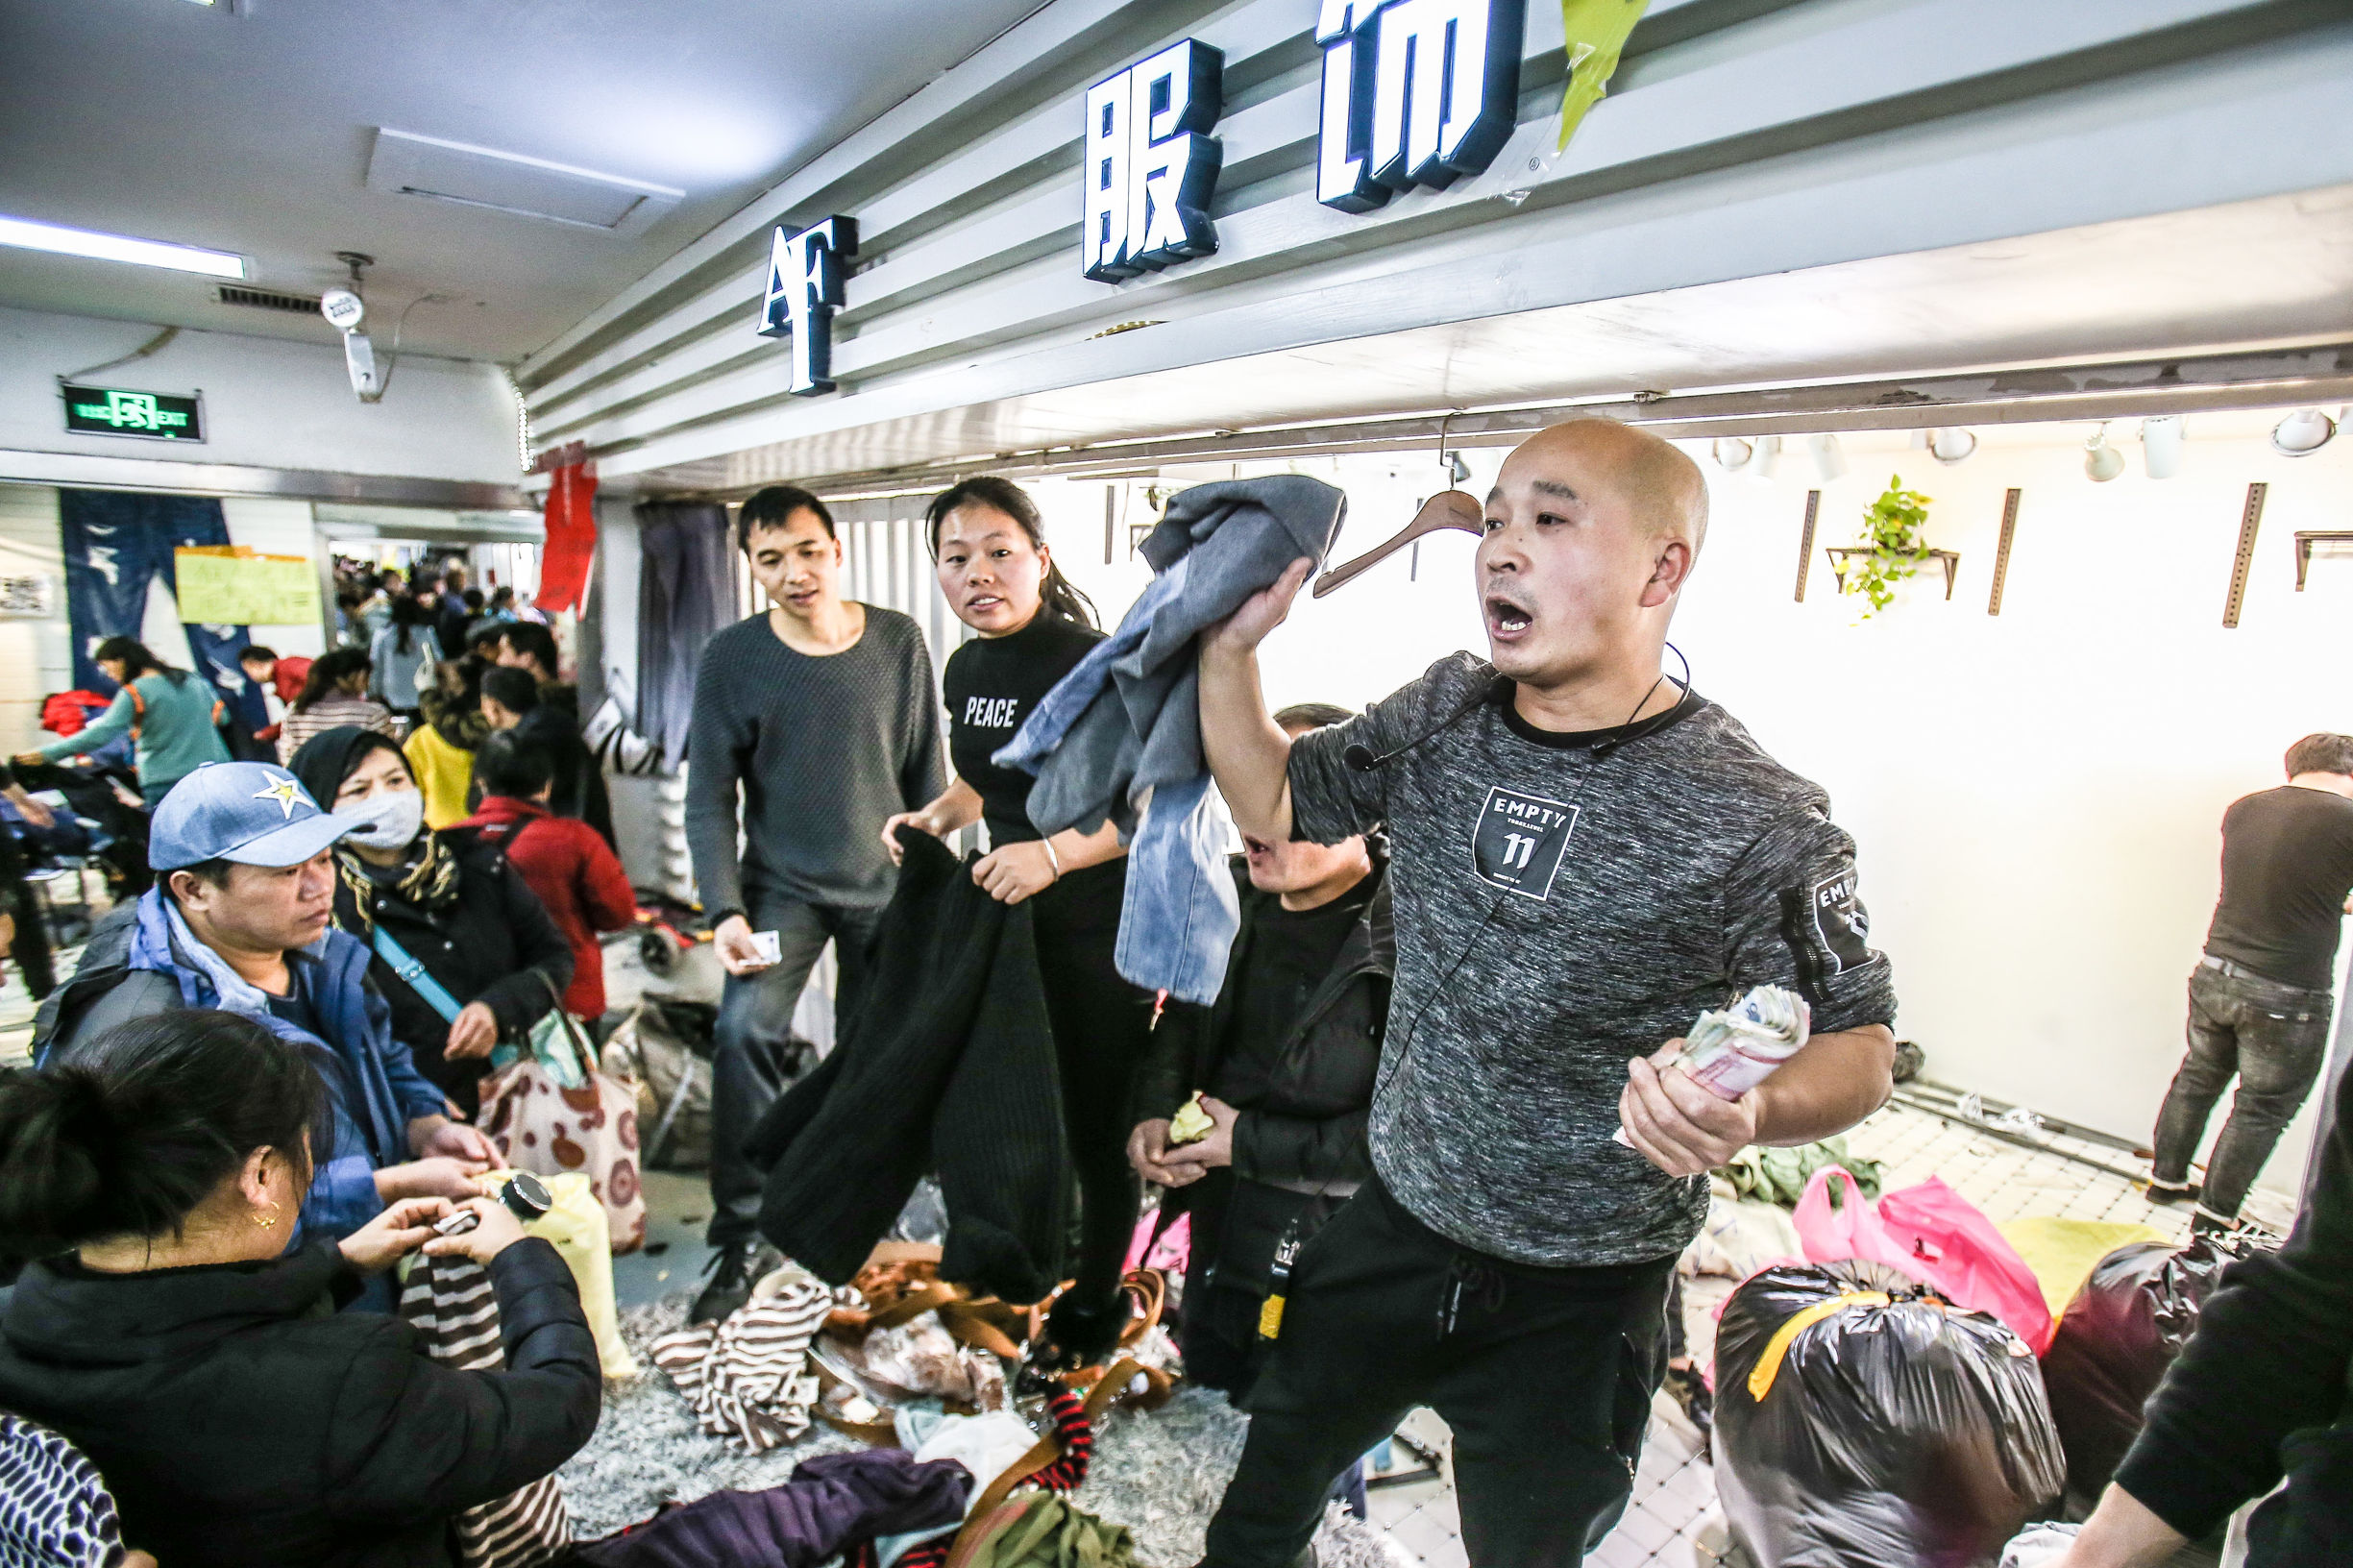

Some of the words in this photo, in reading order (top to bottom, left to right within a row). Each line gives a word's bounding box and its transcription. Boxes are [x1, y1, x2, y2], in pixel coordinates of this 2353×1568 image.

[757, 218, 838, 394] AF
[964, 697, 1018, 727] PEACE
[1494, 797, 1567, 828] EMPTY
[1502, 832, 1536, 870] 11
